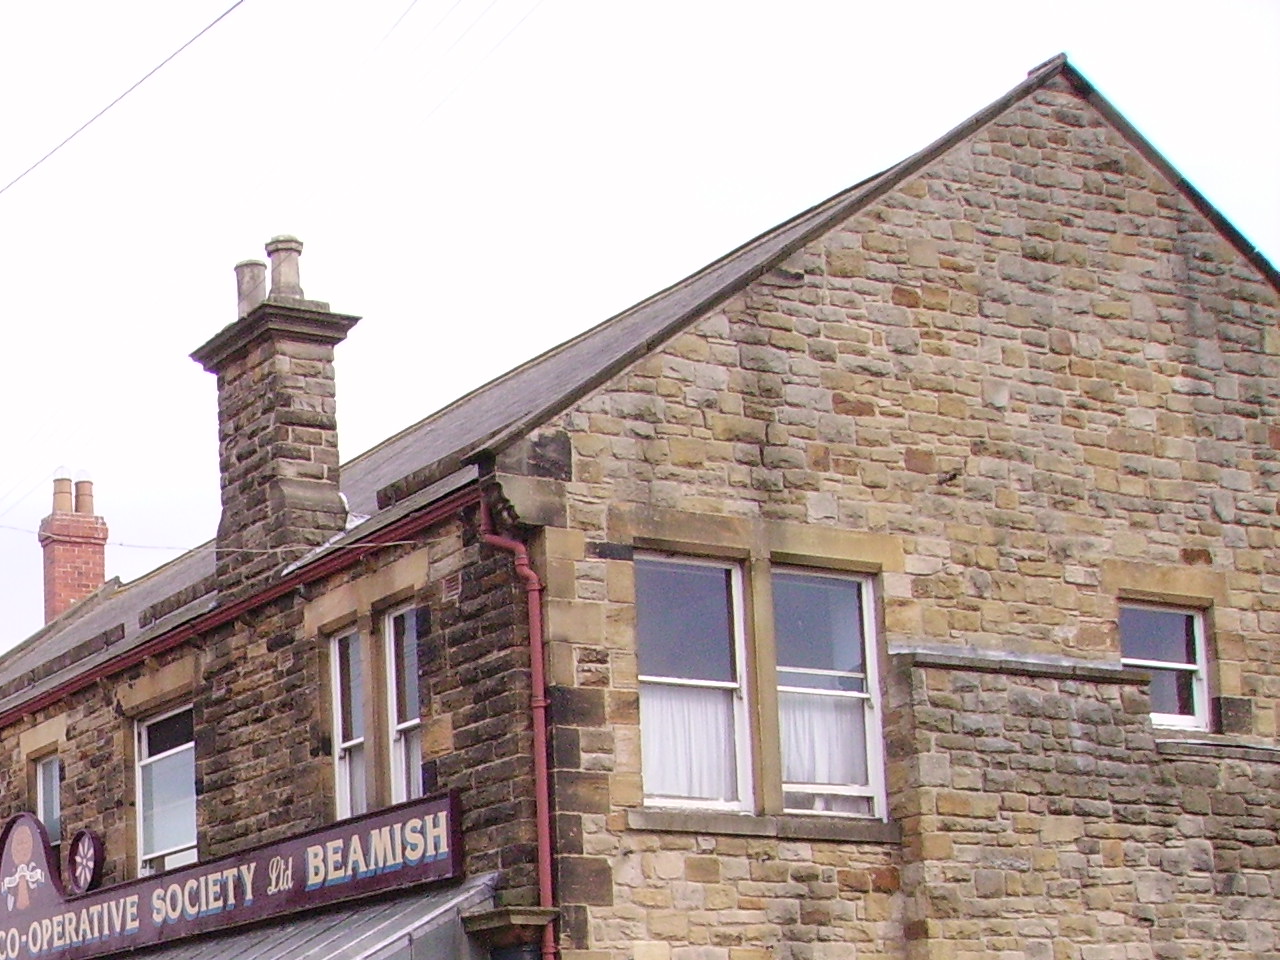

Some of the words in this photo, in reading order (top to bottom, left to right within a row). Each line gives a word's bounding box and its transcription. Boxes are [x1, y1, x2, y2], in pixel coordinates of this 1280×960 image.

[152, 862, 257, 924] SOCIETY
[267, 855, 294, 895] Ltd
[306, 811, 449, 887] BEAMISH
